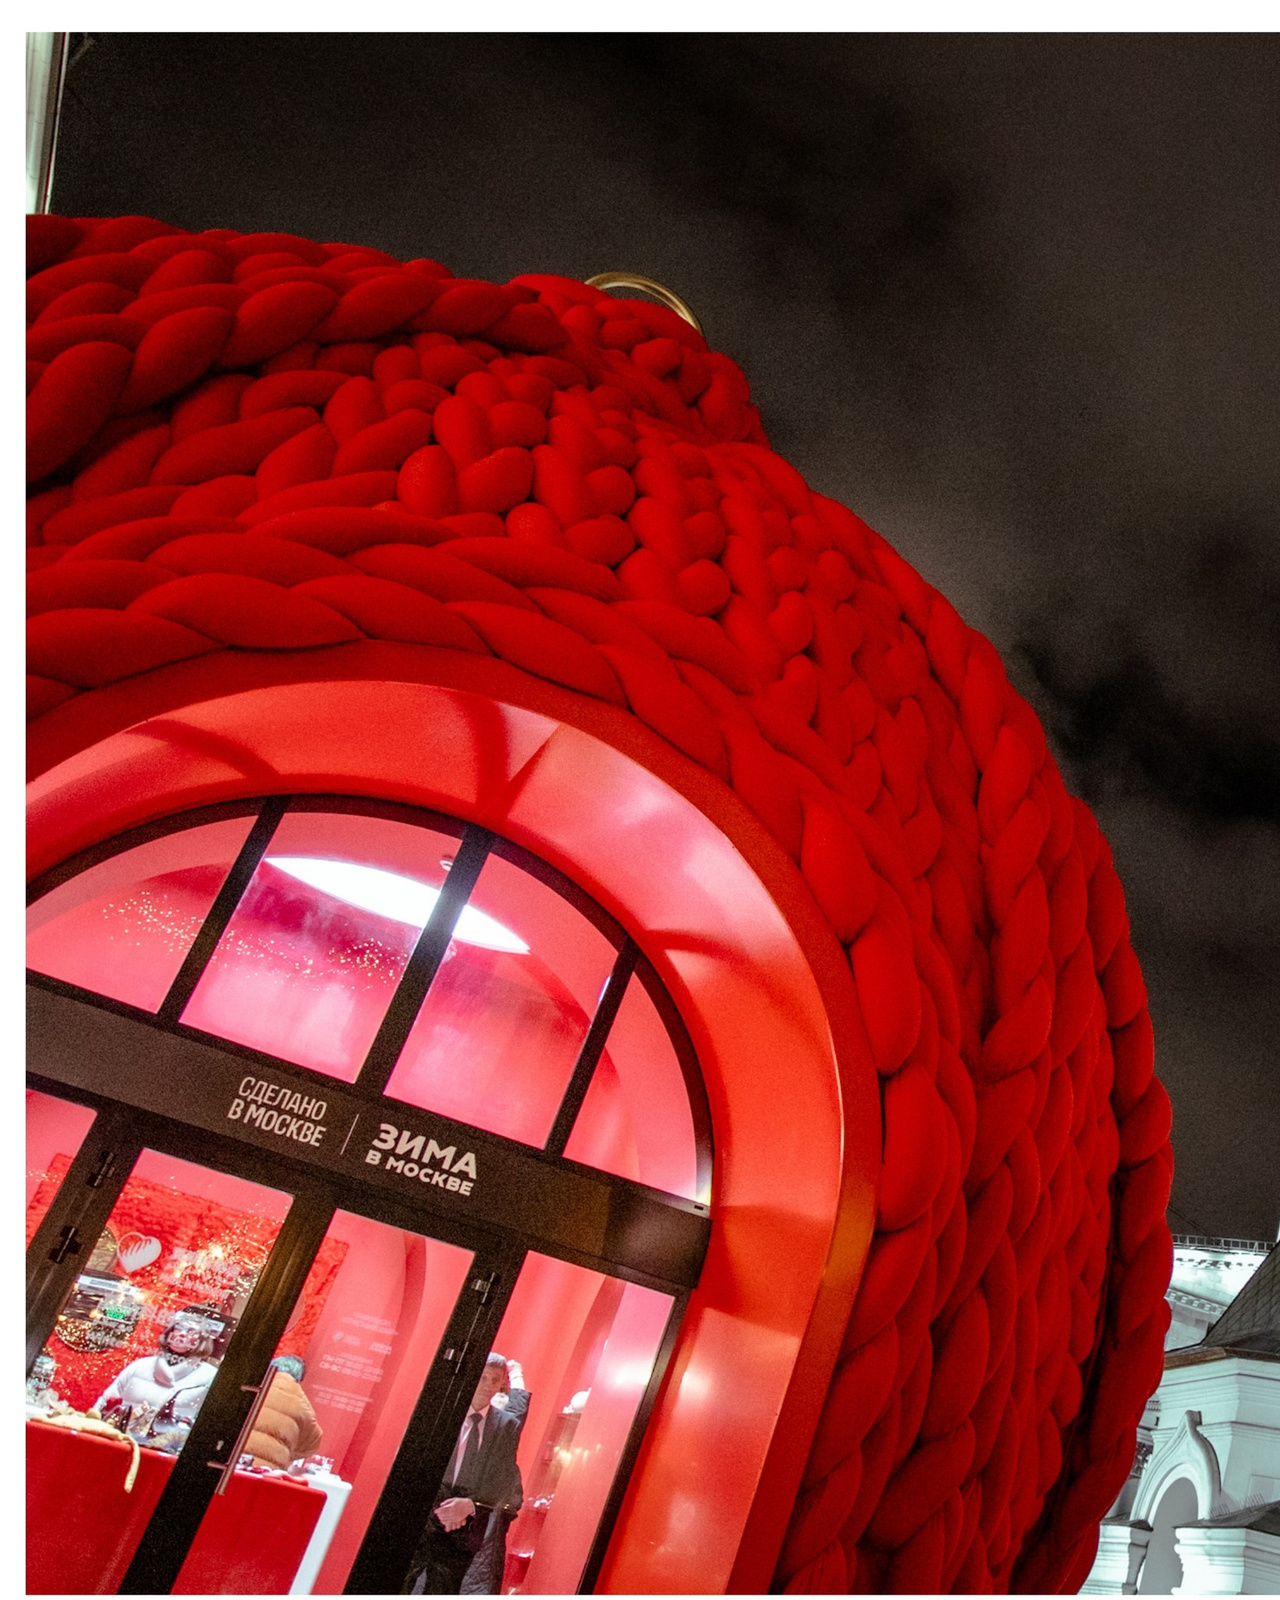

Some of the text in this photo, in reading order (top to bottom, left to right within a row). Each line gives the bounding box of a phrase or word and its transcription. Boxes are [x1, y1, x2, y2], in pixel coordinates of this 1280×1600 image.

[227, 1098, 327, 1147] В МОСКВЕ
[238, 1076, 328, 1121] СДЕЛАНО
[364, 1149, 475, 1196] В МОСКВЕ
[371, 1122, 478, 1180] ЗИМА
